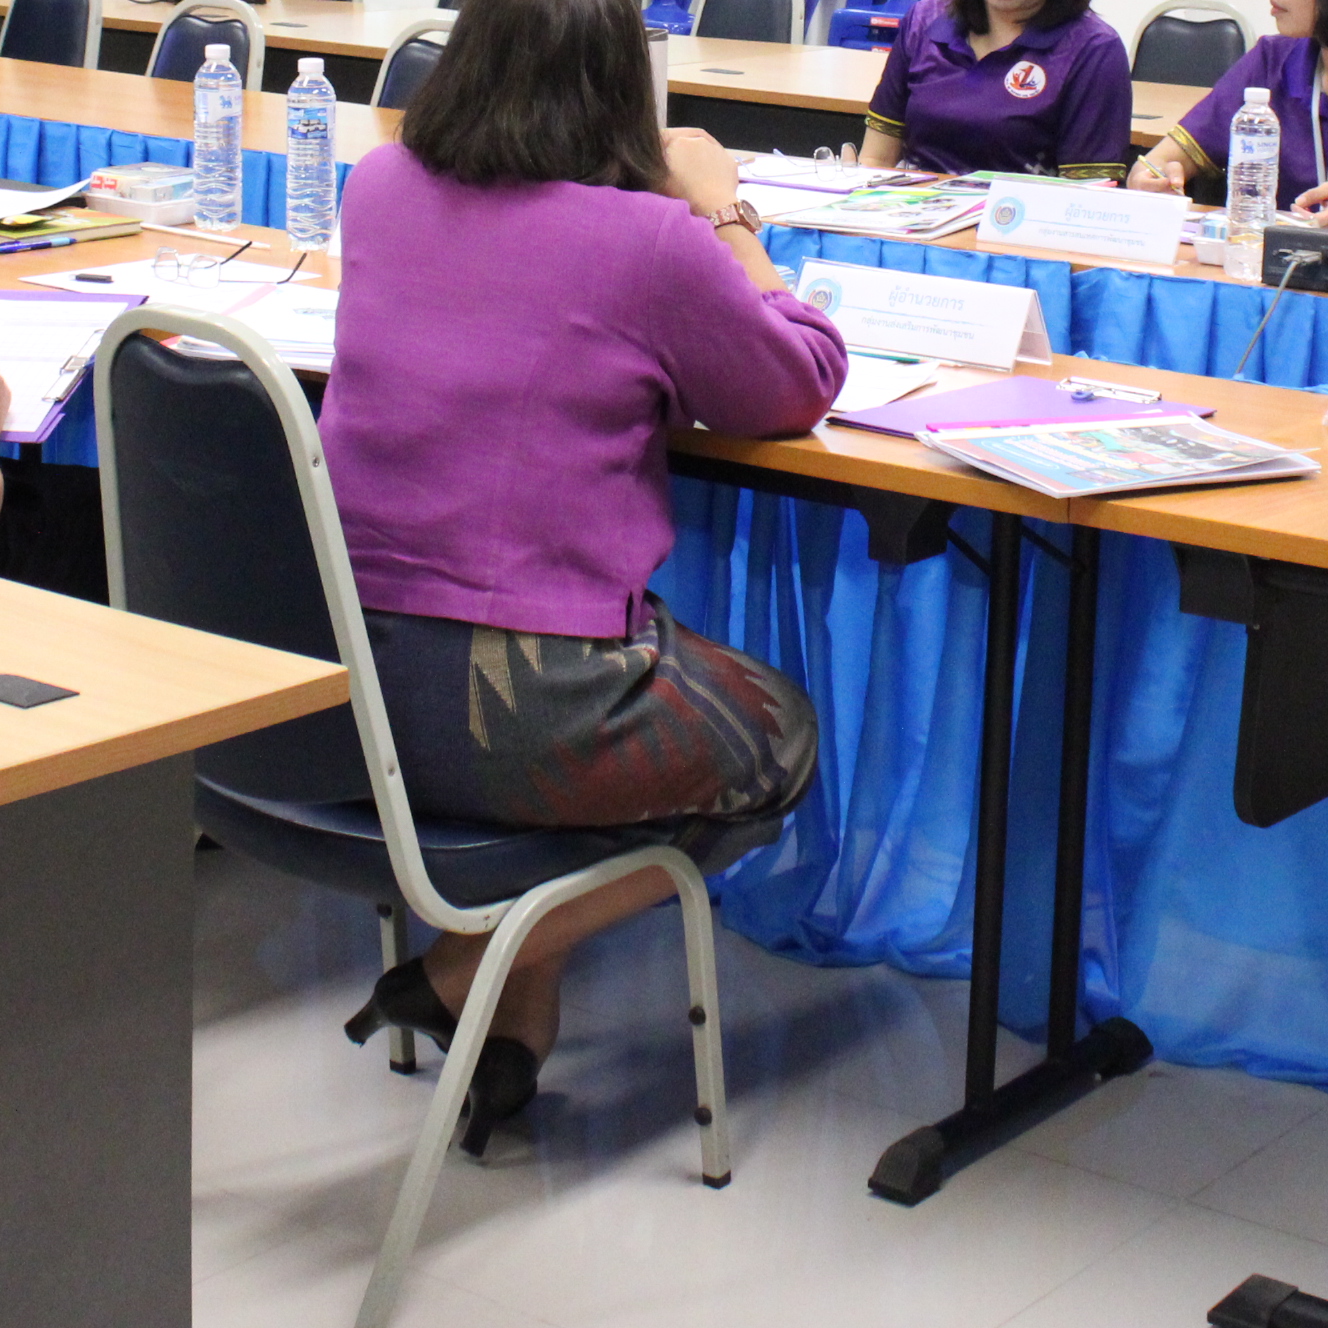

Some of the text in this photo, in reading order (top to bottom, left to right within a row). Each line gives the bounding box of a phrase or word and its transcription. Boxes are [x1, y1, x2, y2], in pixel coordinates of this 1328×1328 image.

[1064, 202, 1131, 224] ผู้อำนวยการ
[888, 284, 966, 311] ผู้อำนวยการ
